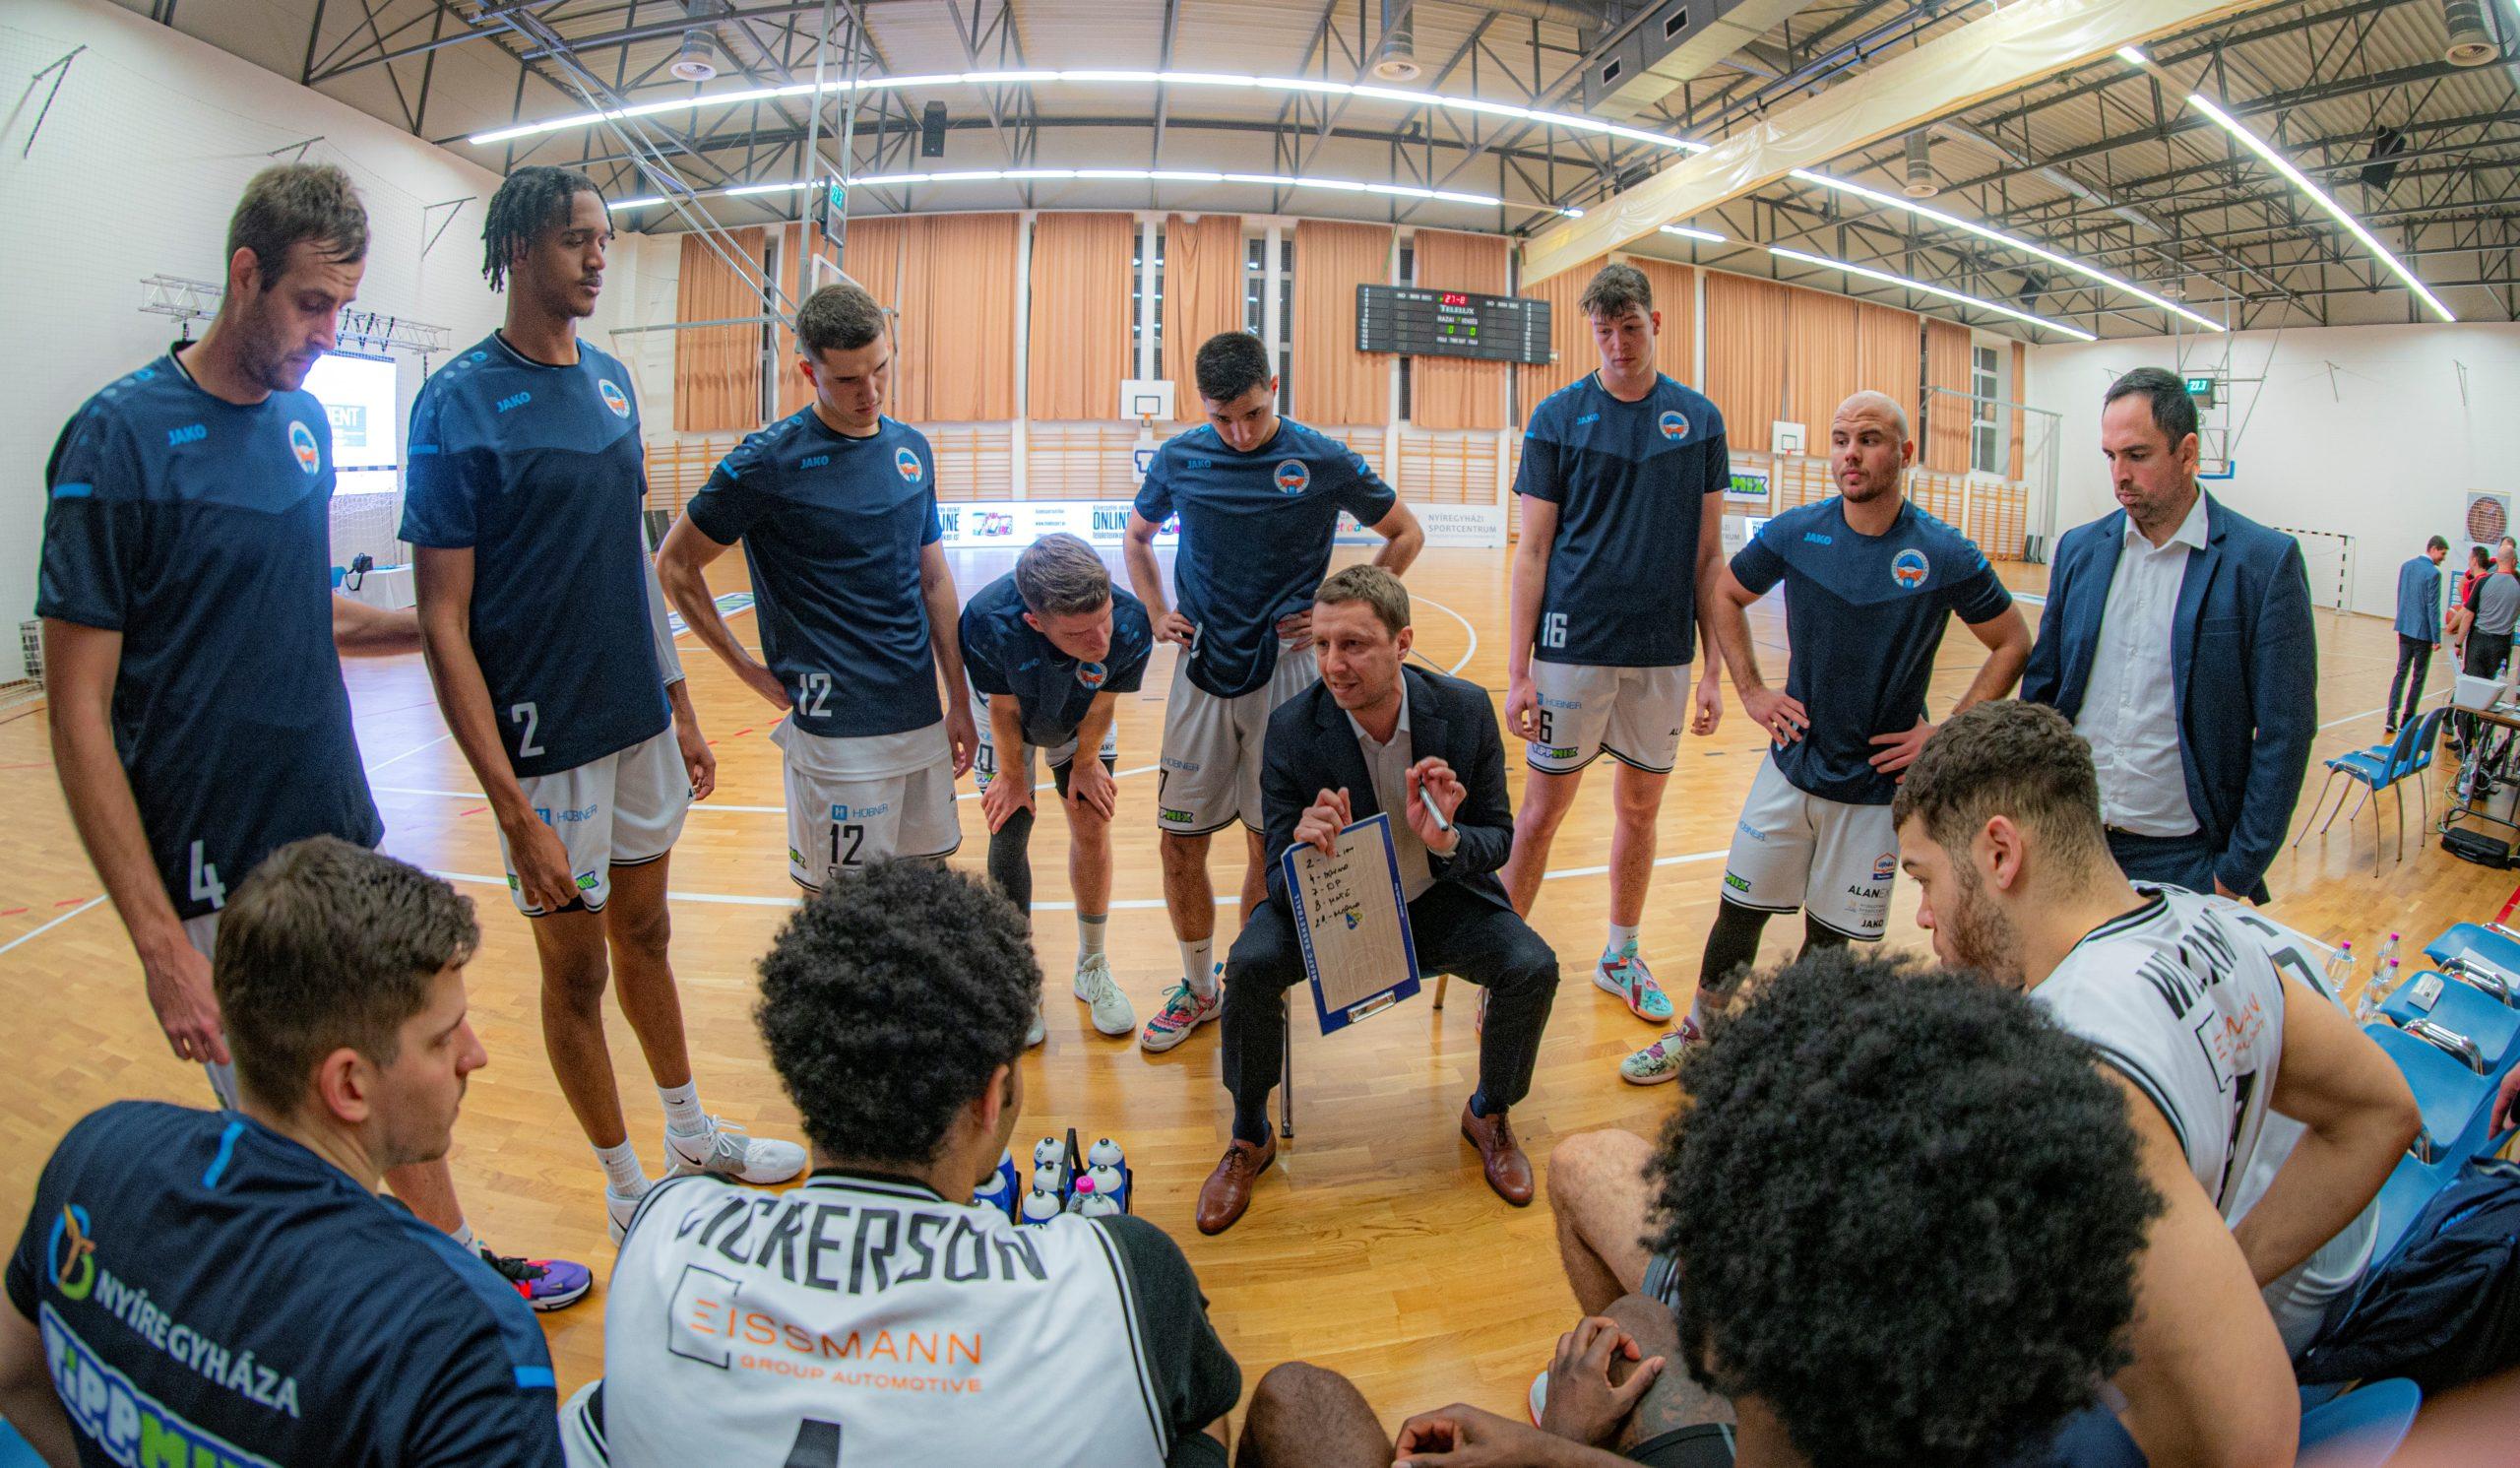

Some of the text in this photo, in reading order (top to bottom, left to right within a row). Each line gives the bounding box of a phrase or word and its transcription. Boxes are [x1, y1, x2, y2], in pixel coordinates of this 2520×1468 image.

[496, 391, 532, 414] JAKO
[1577, 412, 1600, 425] JAKO
[168, 424, 208, 446] JAKO
[799, 455, 829, 470] JAKO
[1187, 459, 1211, 470] JAKO
[1427, 512, 1484, 523] NYÍREGYHÁZI
[1803, 532, 1832, 544] JAKO
[1542, 612, 1568, 648] 16
[799, 672, 832, 718] 12
[511, 701, 545, 757] 2
[830, 823, 864, 865] 12
[190, 839, 226, 910] 4
[1294, 893, 1311, 950] BASKETBALL
[1861, 919, 1884, 928] JAKO
[96, 1269, 301, 1419] NYÍREGYHÁZA
[690, 1298, 982, 1366] EISSMANN
[739, 1353, 982, 1394] GROUP AUTOMOTIVE
